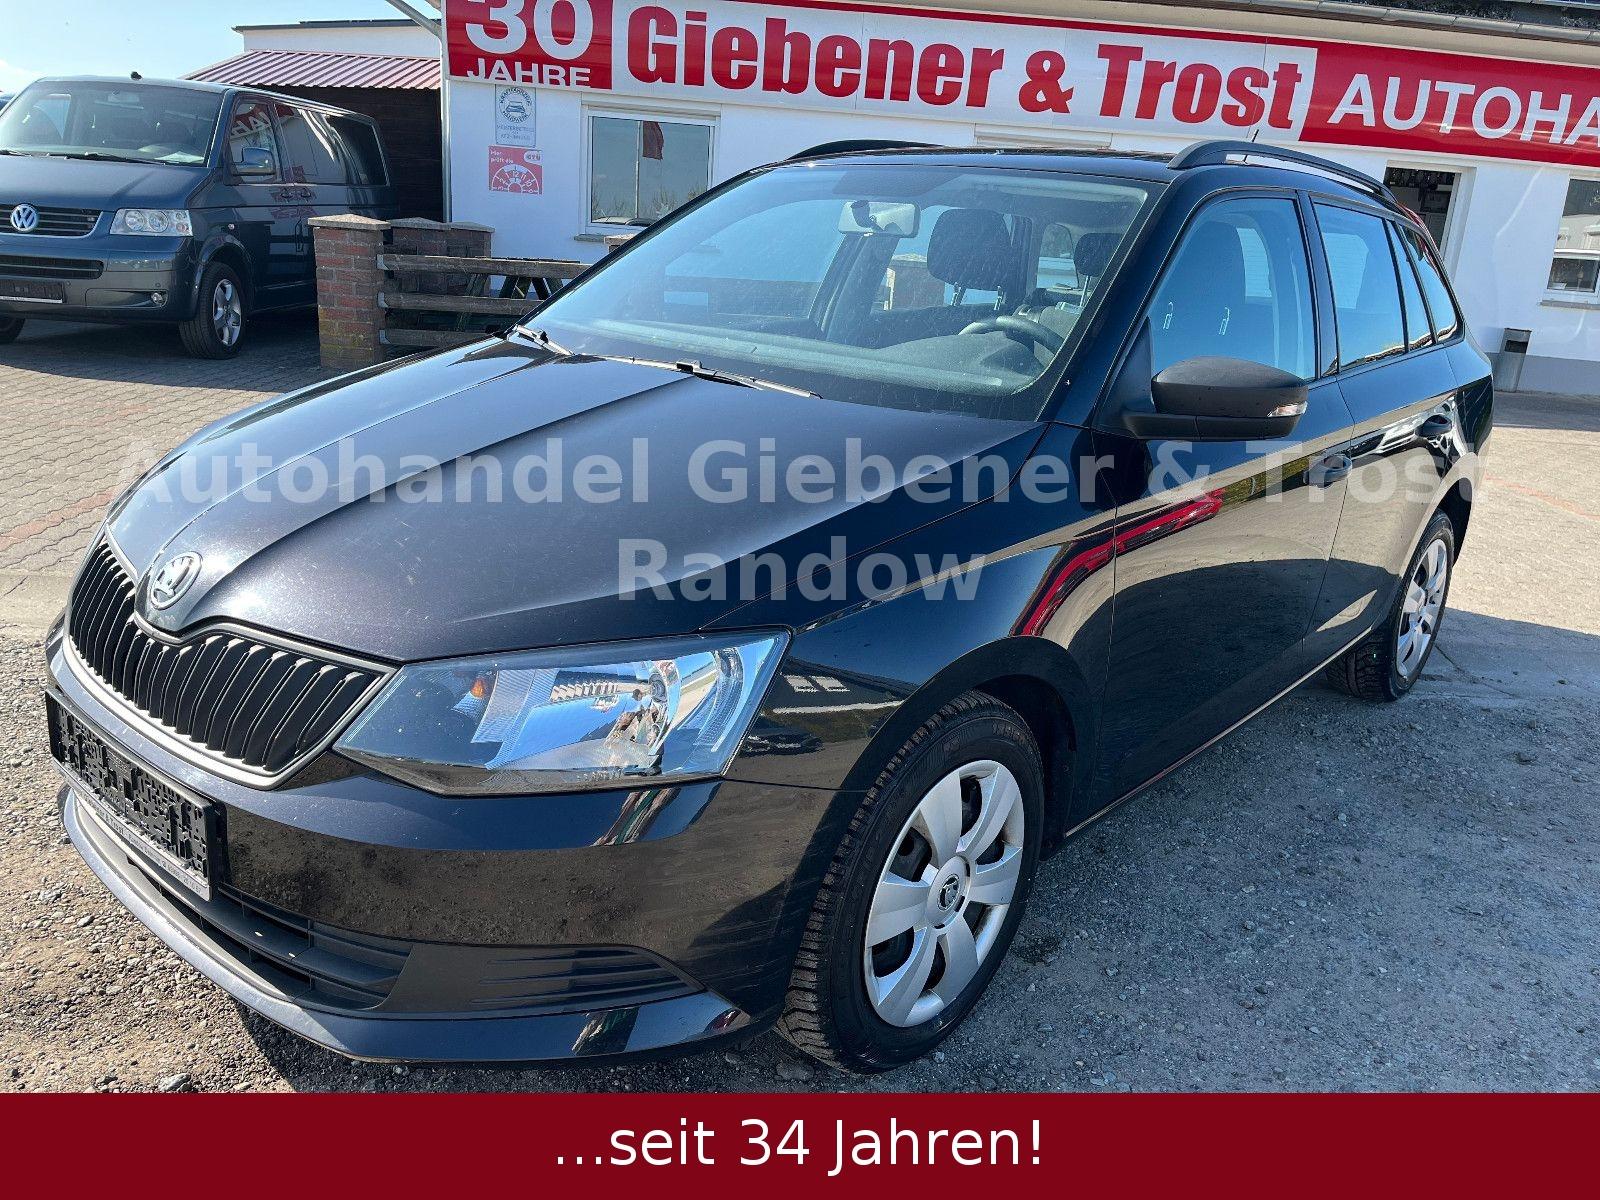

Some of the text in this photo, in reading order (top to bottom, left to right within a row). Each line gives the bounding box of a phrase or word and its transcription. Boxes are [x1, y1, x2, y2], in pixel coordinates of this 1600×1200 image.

[465, 0, 594, 61] 30
[466, 58, 591, 88] JAHRE
[627, 5, 1303, 129] Giebener & Trost
[1327, 73, 1600, 148] AUTOHA
